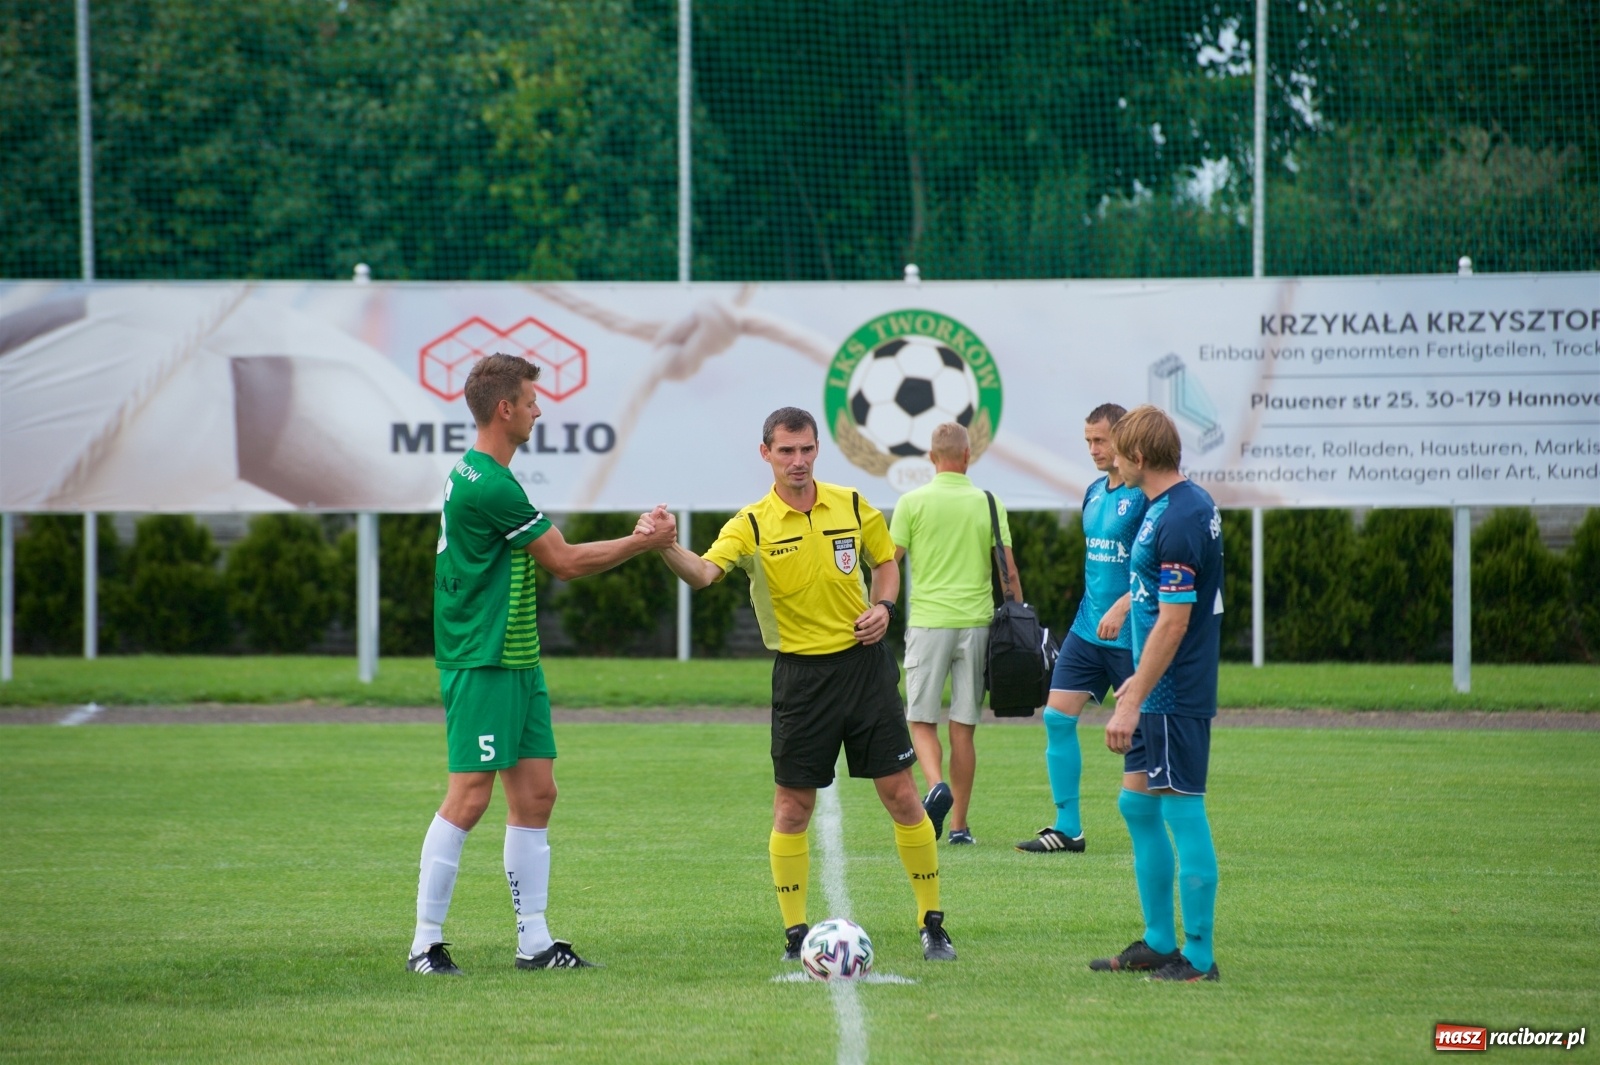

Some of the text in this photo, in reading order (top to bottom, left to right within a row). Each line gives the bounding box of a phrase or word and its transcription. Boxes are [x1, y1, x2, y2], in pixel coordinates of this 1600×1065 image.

[1260, 312, 1419, 336] KRZYKAŁA
[829, 338, 867, 389] LKS
[1199, 344, 1265, 361] Einbau
[1271, 347, 1305, 361] von
[1311, 343, 1420, 364] genormten
[1427, 339, 1547, 363] Fertigteilen,
[1251, 393, 1346, 410] Plauener
[1352, 392, 1381, 409] str
[1387, 390, 1419, 408] 25.
[1426, 390, 1501, 408] 30-179
[391, 422, 617, 454] MELIO
[1240, 437, 1600, 459] Fenster, Rolladen, Hausturen, Markis
[1348, 464, 1450, 485] Montagen
[1457, 463, 1501, 481] aller
[1506, 463, 1541, 482] Art,
[1547, 462, 1600, 480] Kund
[1089, 537, 1116, 551] SPORT
[478, 734, 496, 762] 5
